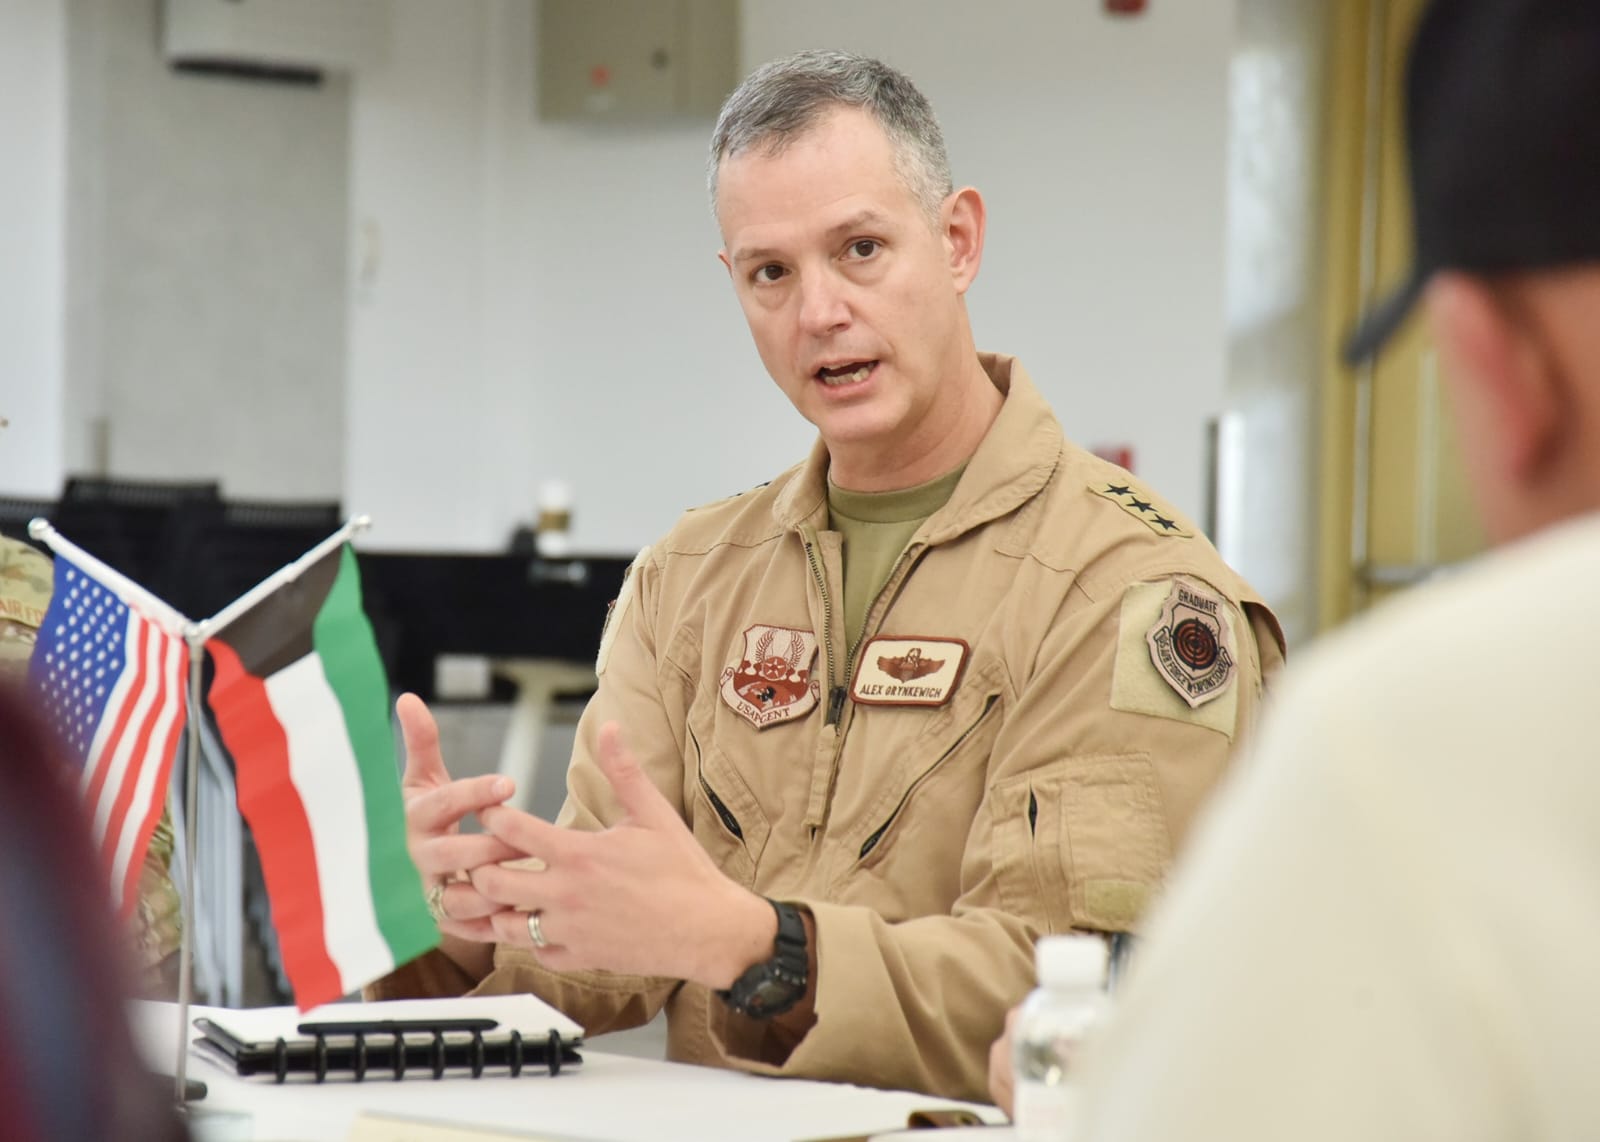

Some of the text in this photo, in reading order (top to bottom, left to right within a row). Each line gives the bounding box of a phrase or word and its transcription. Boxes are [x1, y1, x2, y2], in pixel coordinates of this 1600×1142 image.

[1178, 589, 1218, 614] GRADUATE
[1167, 660, 1187, 685] FORCE
[860, 684, 883, 695] ALEX
